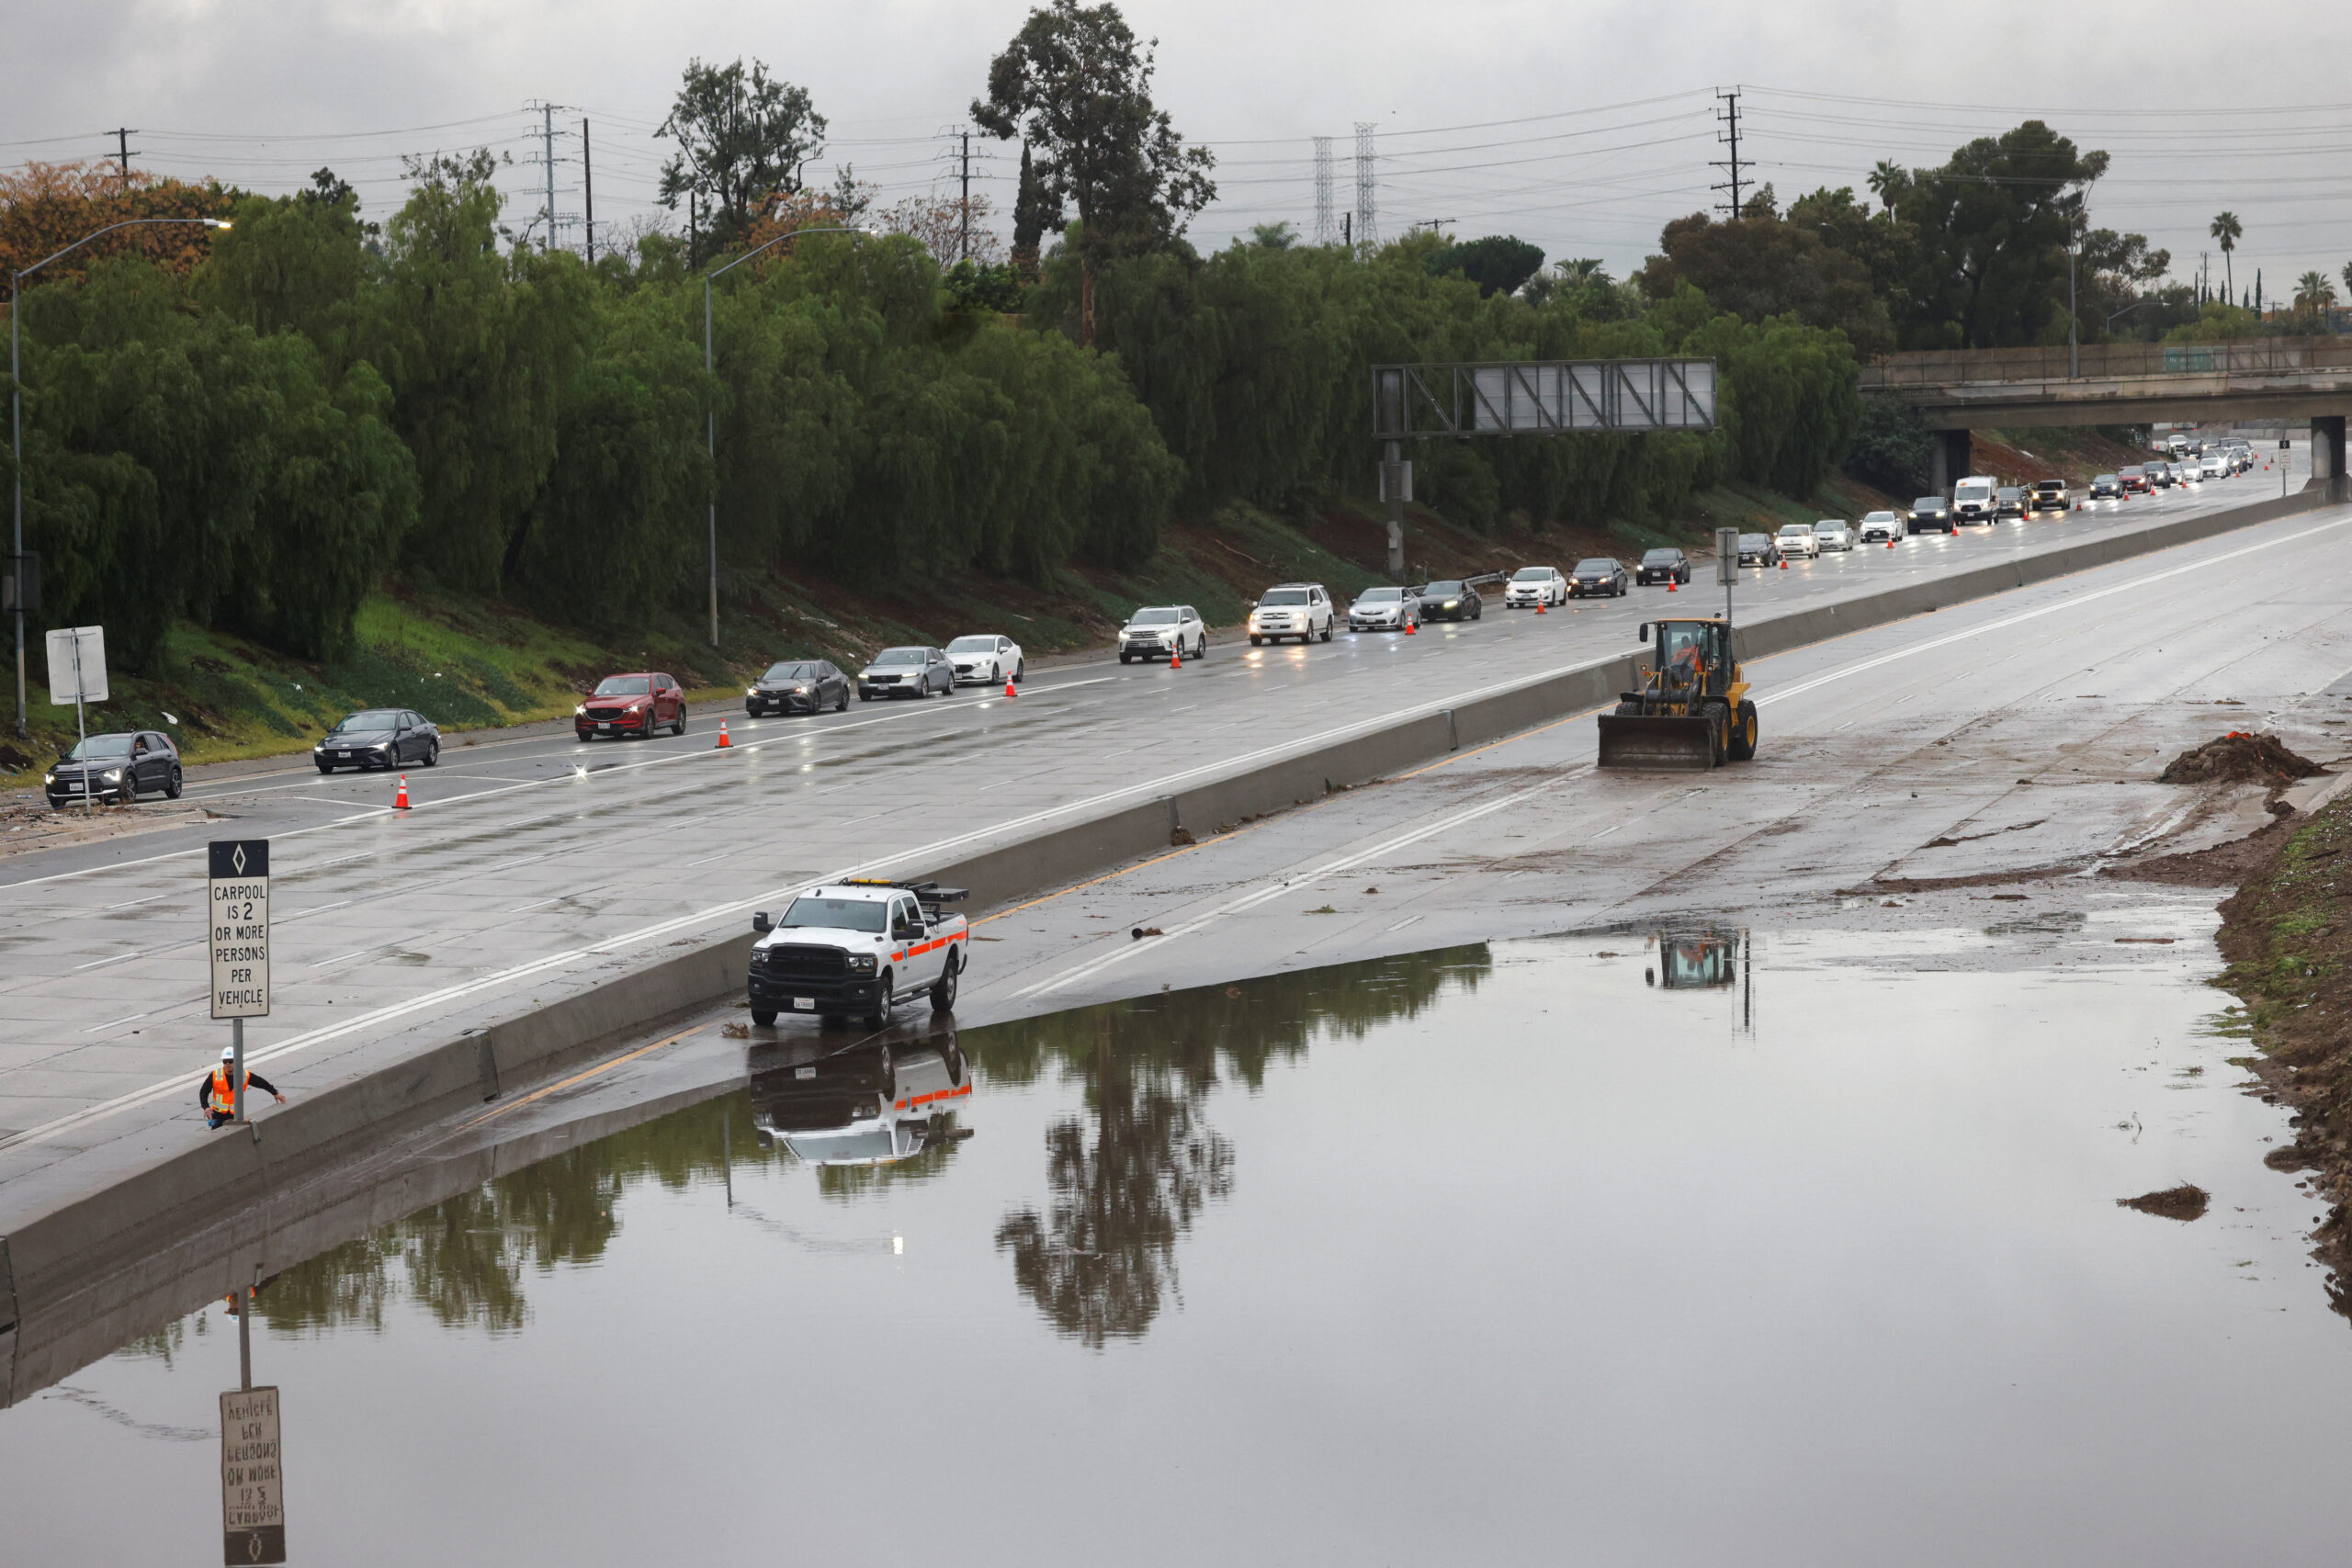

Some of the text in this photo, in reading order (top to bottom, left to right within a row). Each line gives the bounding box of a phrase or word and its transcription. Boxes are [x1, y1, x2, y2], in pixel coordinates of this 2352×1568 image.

[214, 885, 266, 901] CARPOOL
[228, 901, 253, 920] IS 2
[215, 925, 265, 941] OR MORE
[216, 946, 265, 962] PERSONS
[232, 968, 252, 983] PER
[219, 989, 263, 1005] VEHICLE
